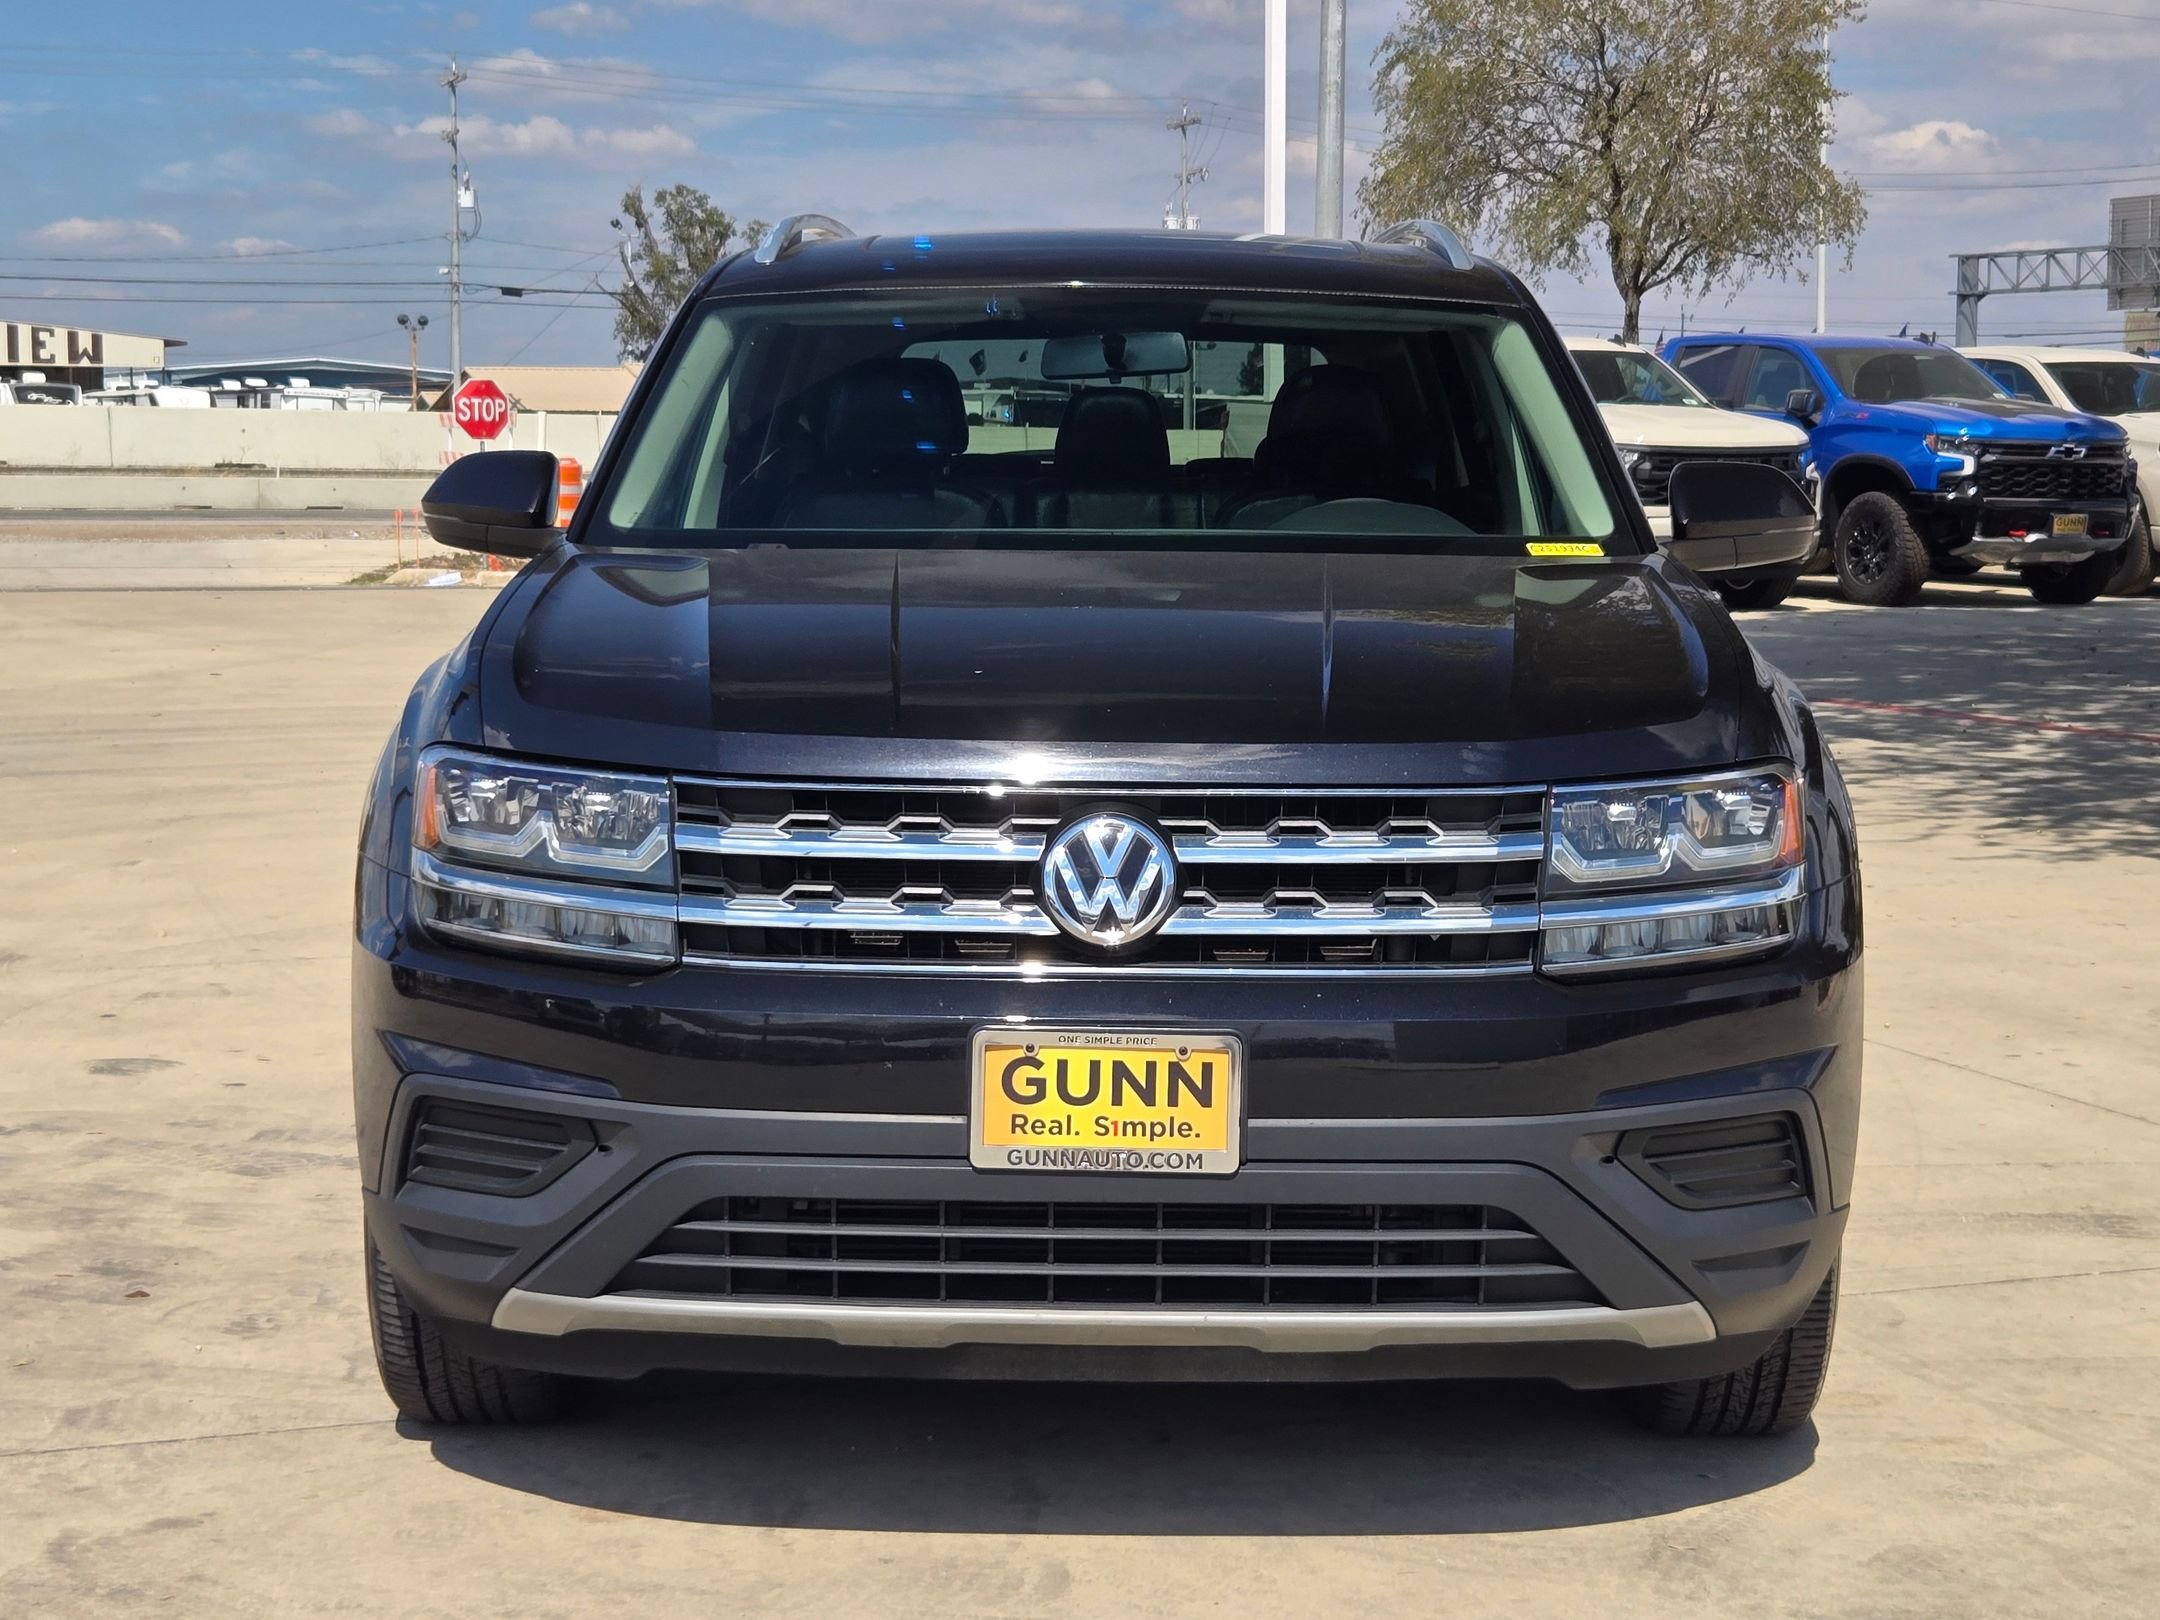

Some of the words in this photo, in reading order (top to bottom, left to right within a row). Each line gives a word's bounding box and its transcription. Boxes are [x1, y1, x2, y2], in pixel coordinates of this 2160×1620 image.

[7, 324, 104, 364] IEW
[458, 397, 506, 422] STOP
[2055, 517, 2084, 527] GUNN
[1051, 826, 1160, 936] VW
[1058, 1035, 1081, 1043] ONE
[1084, 1036, 1123, 1044] SIMPLE
[1126, 1037, 1158, 1045] PRICE
[1001, 1056, 1214, 1108] GUNN
[1011, 1114, 1080, 1136] Real.
[1007, 1149, 1203, 1170] GUNNAUTO.COM
